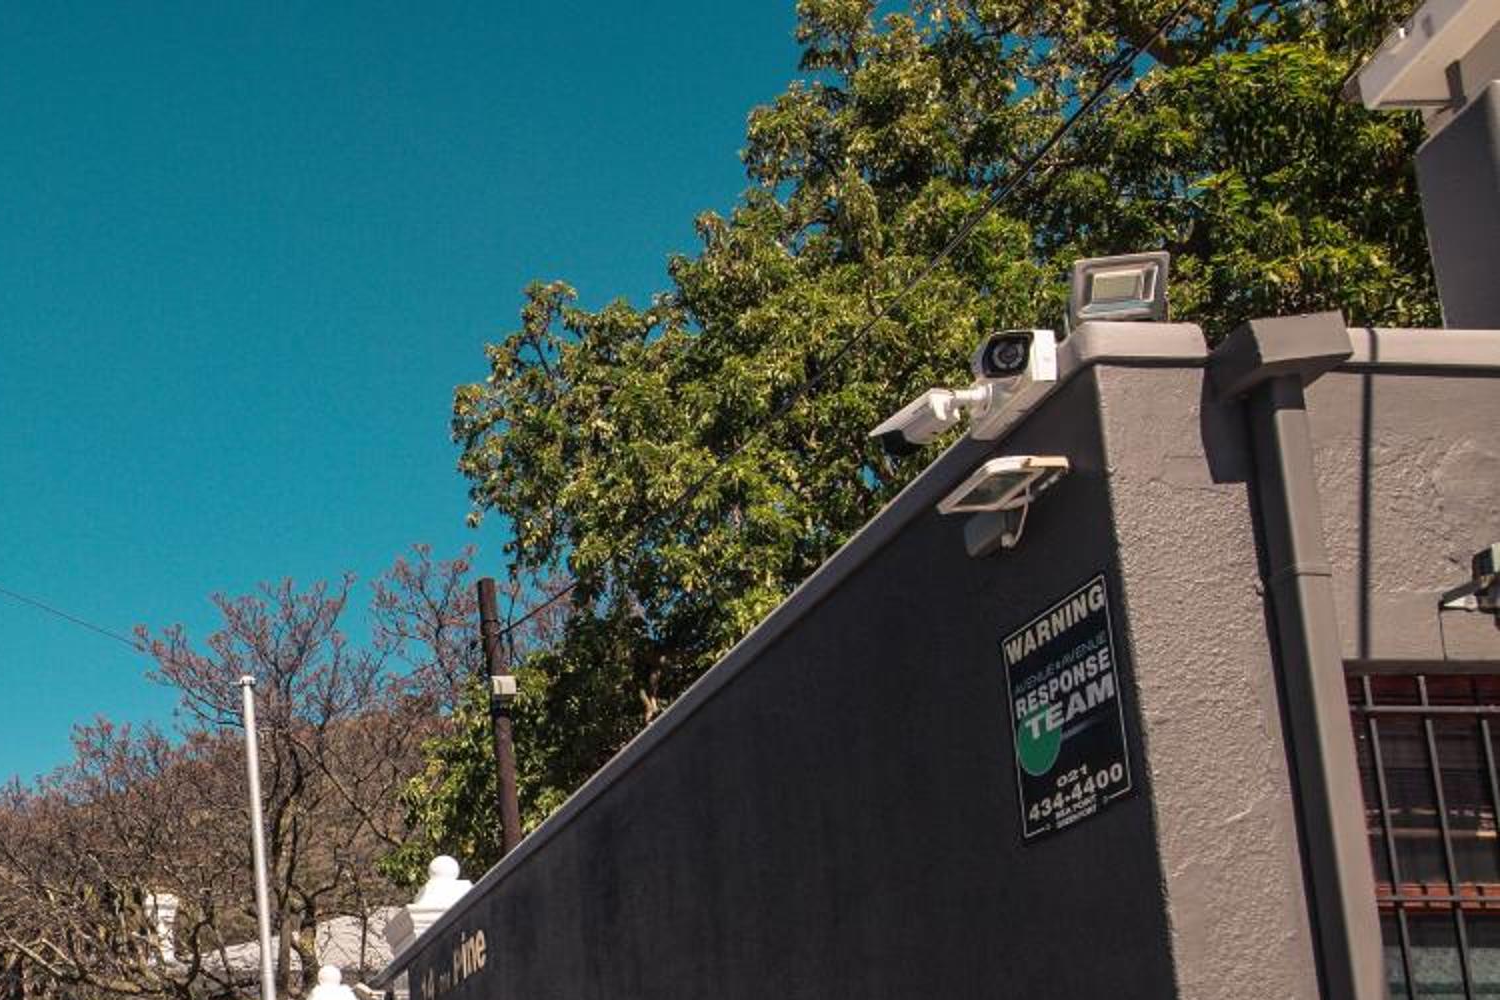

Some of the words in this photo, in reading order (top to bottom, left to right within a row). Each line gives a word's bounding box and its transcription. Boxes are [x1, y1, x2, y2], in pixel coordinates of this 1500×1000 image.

[1004, 584, 1106, 666] WARNING
[1015, 647, 1111, 720] RESPONSE
[1024, 676, 1116, 740] TEAM
[1056, 765, 1088, 788] 021
[453, 929, 487, 986] Pine
